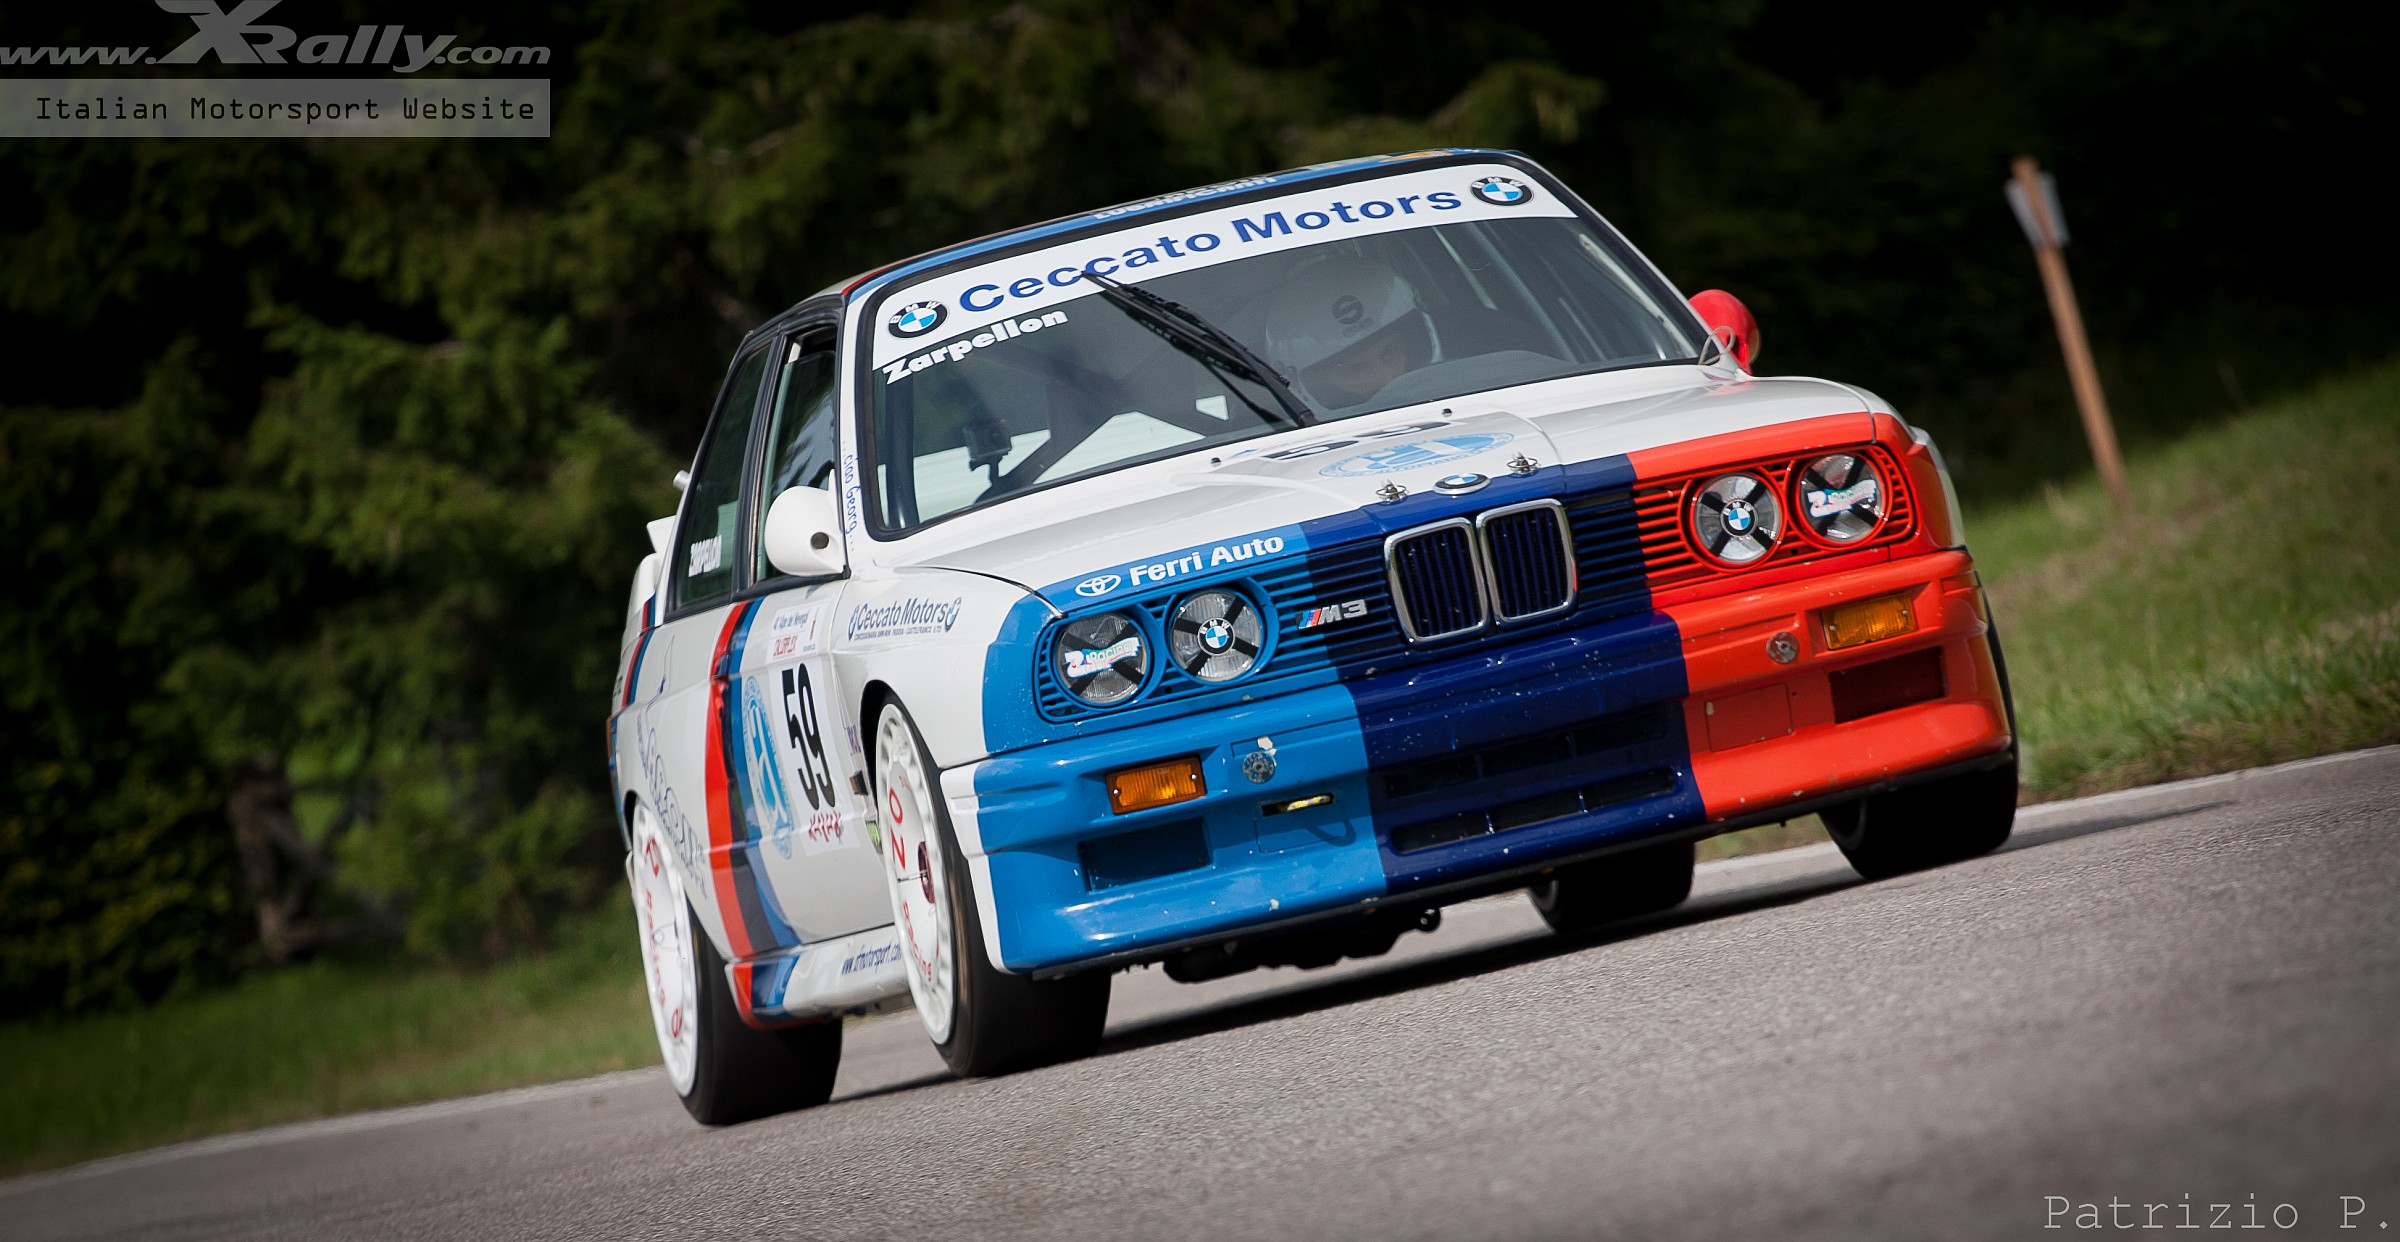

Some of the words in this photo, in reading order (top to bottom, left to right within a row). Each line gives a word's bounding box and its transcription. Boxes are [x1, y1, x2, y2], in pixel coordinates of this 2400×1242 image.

[959, 234, 1221, 314] Ceccato
[1231, 187, 1462, 245] Motors
[882, 310, 1069, 385] Zarpellon
[1129, 551, 1202, 587] Ferri
[1210, 535, 1285, 568] Auto
[857, 603, 902, 631] Ceccato
[901, 597, 949, 625] Motors
[1321, 599, 1368, 625] M3
[781, 663, 835, 811] 59
